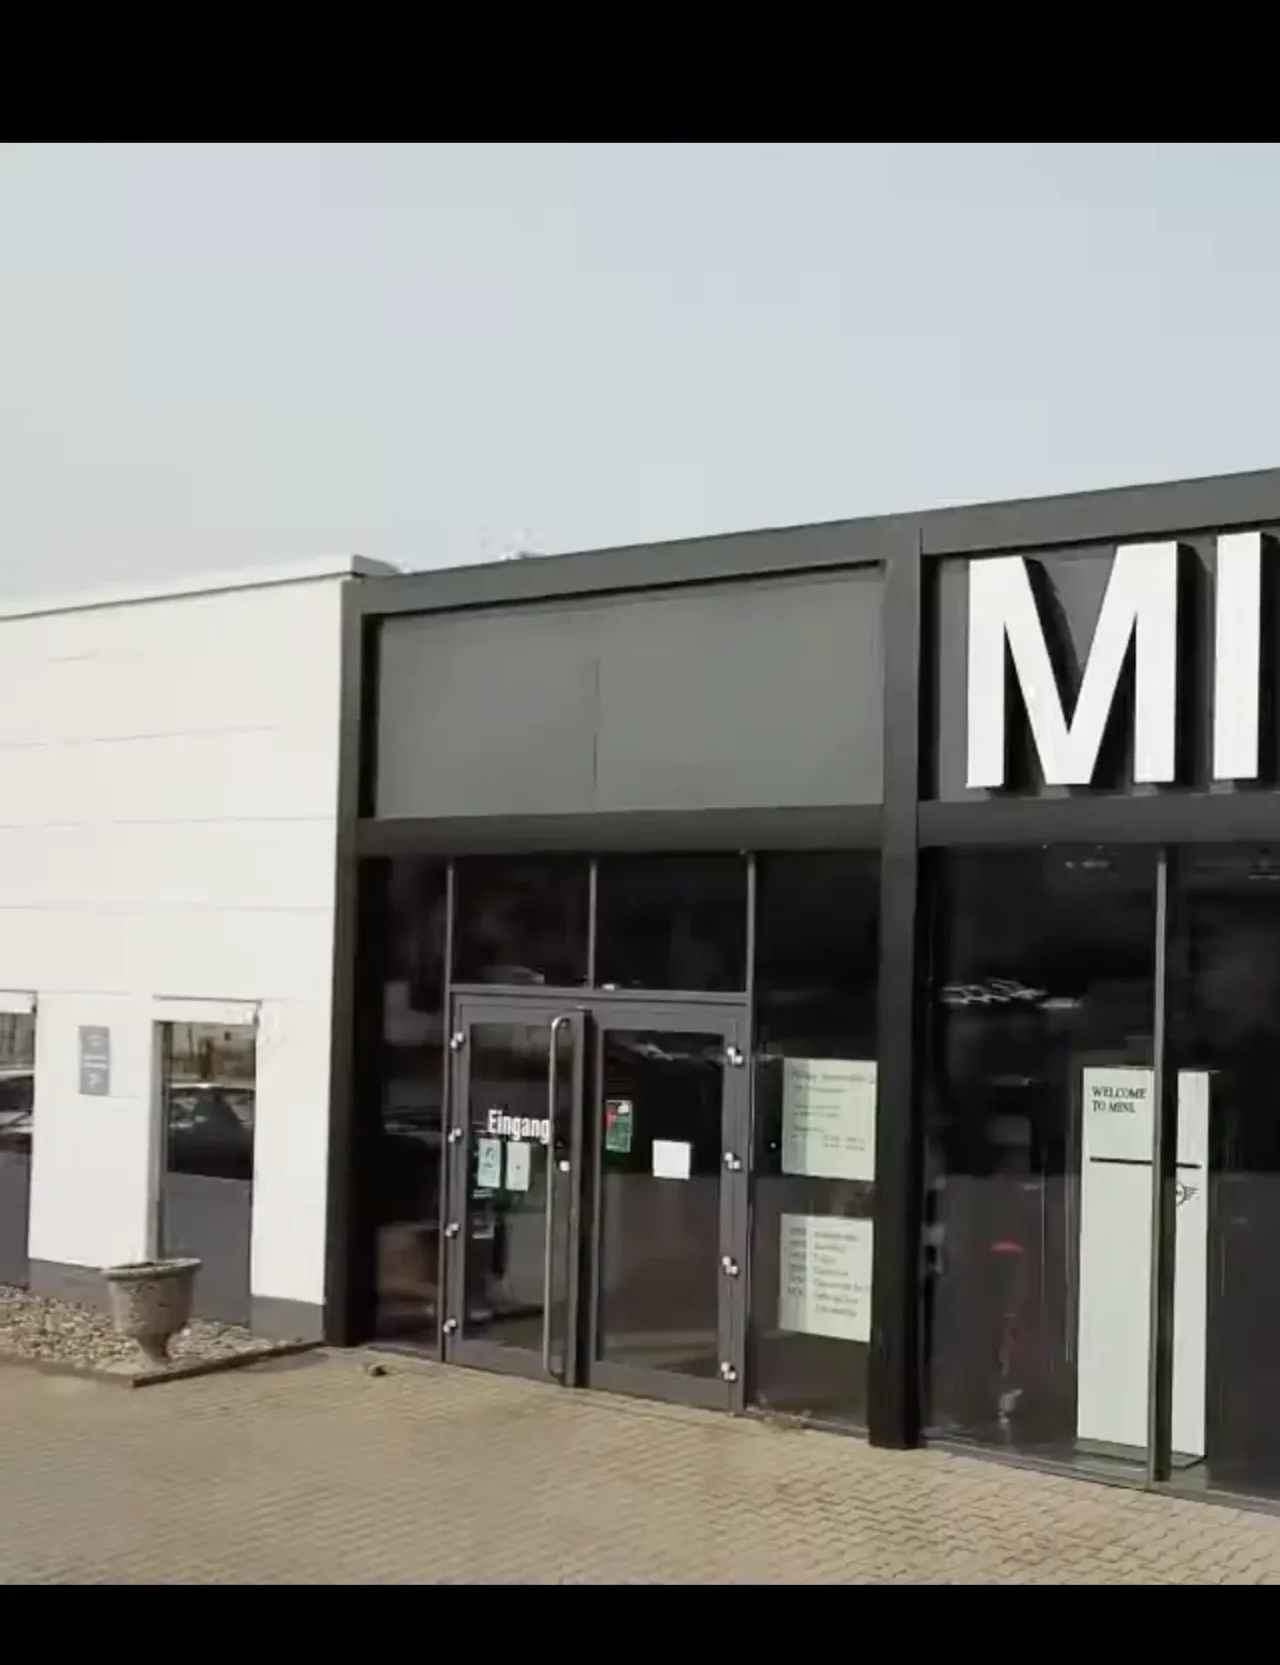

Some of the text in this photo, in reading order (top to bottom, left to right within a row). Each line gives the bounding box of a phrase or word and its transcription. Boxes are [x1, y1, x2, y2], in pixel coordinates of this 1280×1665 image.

[1091, 1085, 1148, 1100] WELCOME
[1091, 1099, 1107, 1112] TO
[488, 1109, 551, 1145] Eingang
